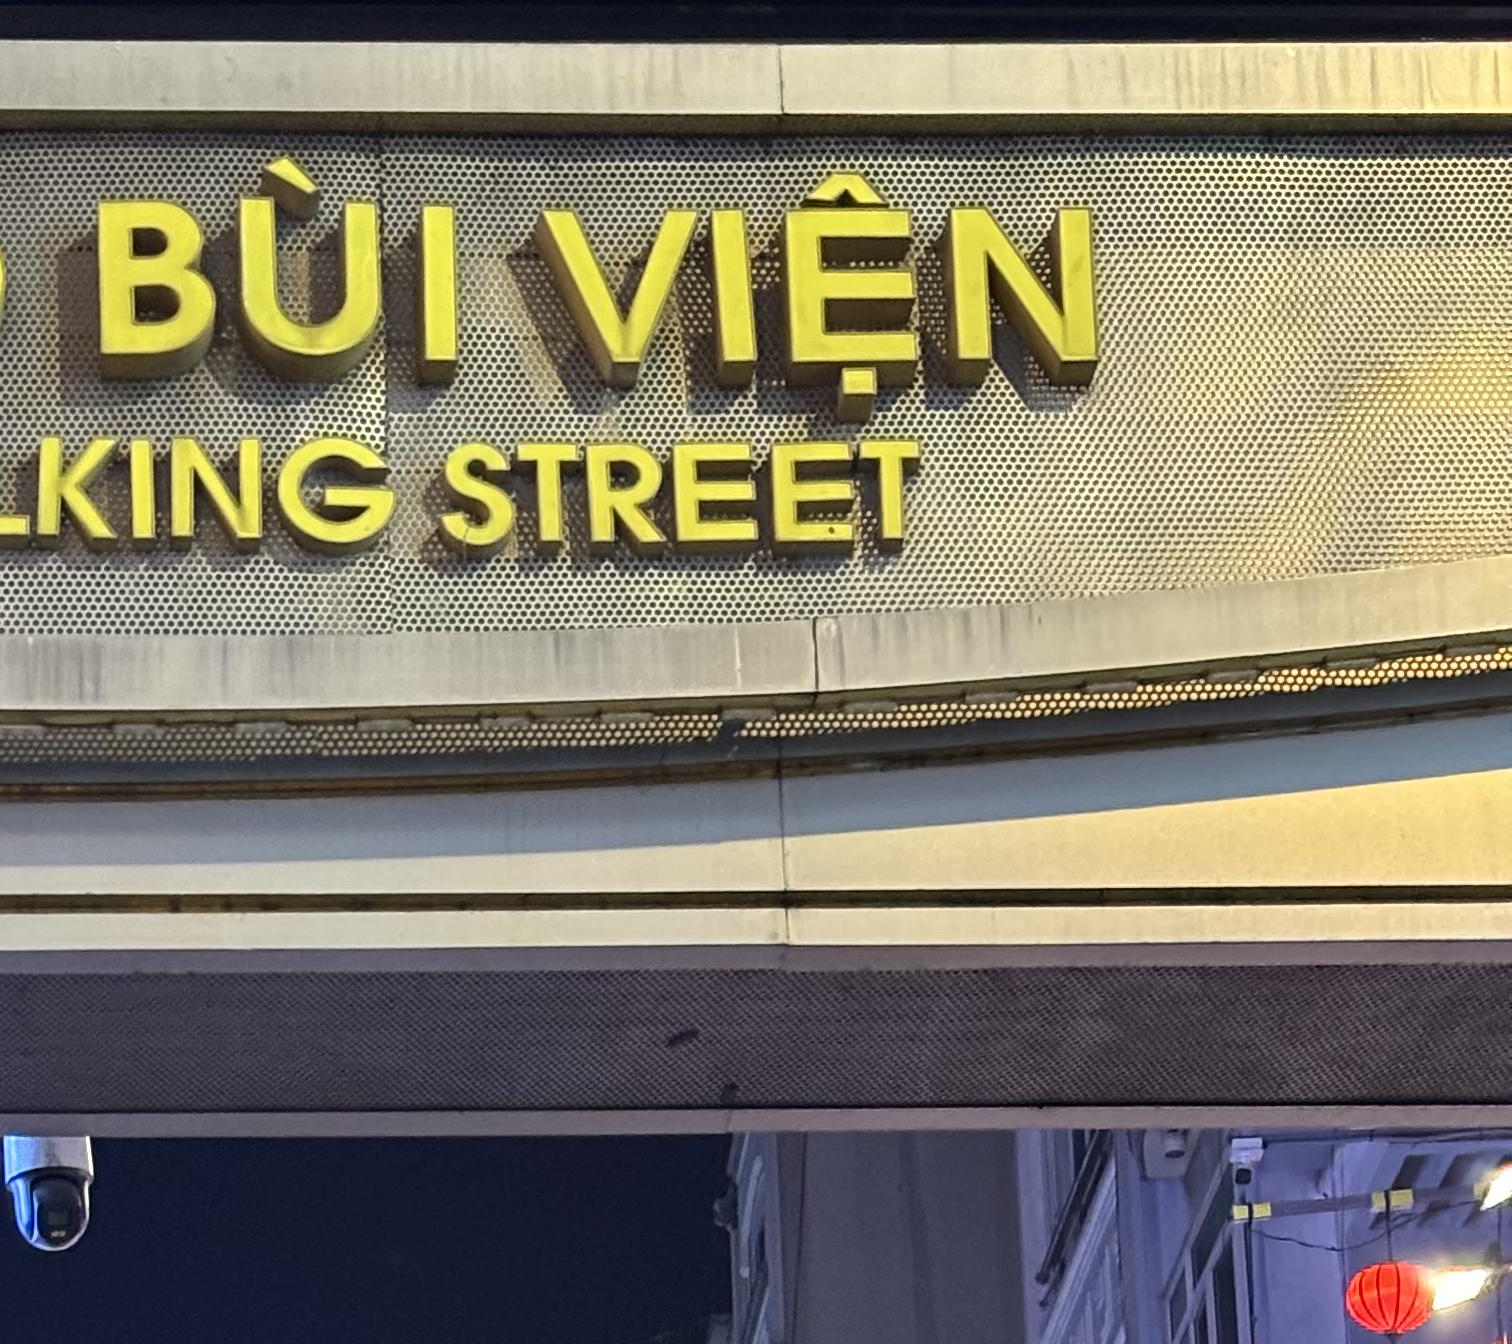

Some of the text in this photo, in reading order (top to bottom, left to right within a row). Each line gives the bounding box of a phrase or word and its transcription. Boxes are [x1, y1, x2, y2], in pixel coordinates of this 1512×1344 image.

[97, 156, 458, 380] BÙI
[535, 171, 1100, 415] VIỆN
[436, 438, 922, 556] STREET
